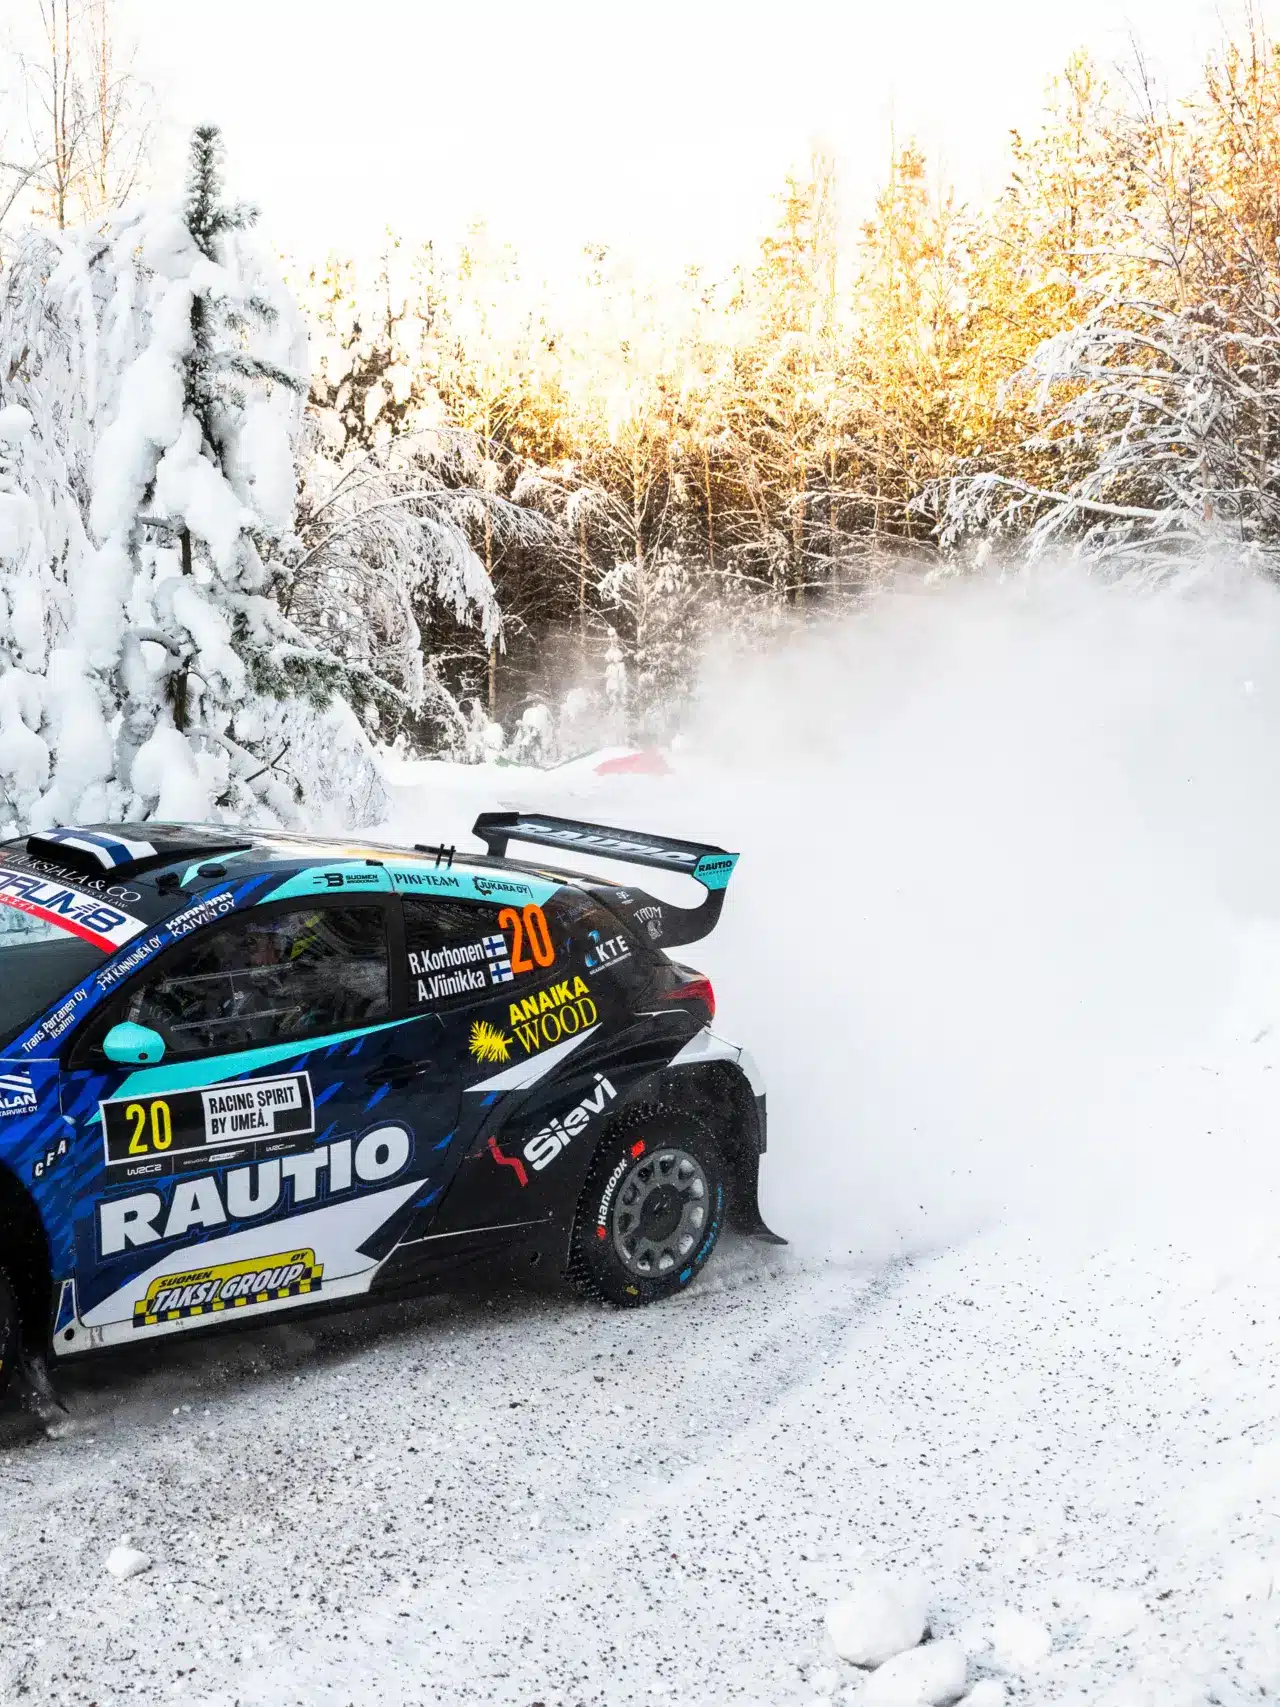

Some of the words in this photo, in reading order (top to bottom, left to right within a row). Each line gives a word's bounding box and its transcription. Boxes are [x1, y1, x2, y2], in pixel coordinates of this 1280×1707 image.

[394, 873, 460, 887] PIKI-TEAM
[698, 860, 733, 872] RAUTIO
[87, 878, 105, 889] &
[106, 886, 141, 902] CO
[479, 881, 515, 892] JUKARA
[515, 886, 528, 894] OY
[218, 899, 236, 914] OY
[498, 903, 555, 974] 20
[595, 935, 629, 962] KTE
[96, 974, 116, 991] J-M
[114, 944, 151, 977] KINNUNEN
[150, 935, 162, 949] OY
[408, 943, 485, 975] R.Korhonen
[417, 969, 486, 1002] A.Viinikka
[509, 975, 590, 1026] ANAIKA
[22, 1031, 46, 1053] Trans
[42, 999, 77, 1033] Partanen
[76, 988, 88, 1002] Oy
[51, 1014, 75, 1040] Iisalmi
[513, 997, 598, 1053] WOOD
[27, 1105, 38, 1113] OY
[208, 1092, 254, 1115] RACING
[258, 1086, 295, 1106] SPIRIT
[125, 1100, 173, 1155] 20
[211, 1118, 228, 1135] BY
[127, 1163, 162, 1176] WRC2
[99, 1126, 410, 1256] RAUTIO
[158, 1270, 212, 1289] SUOMEN
[290, 1253, 307, 1263] OY
[150, 1283, 220, 1313] TAKSI
[220, 1263, 304, 1298] GROUP
